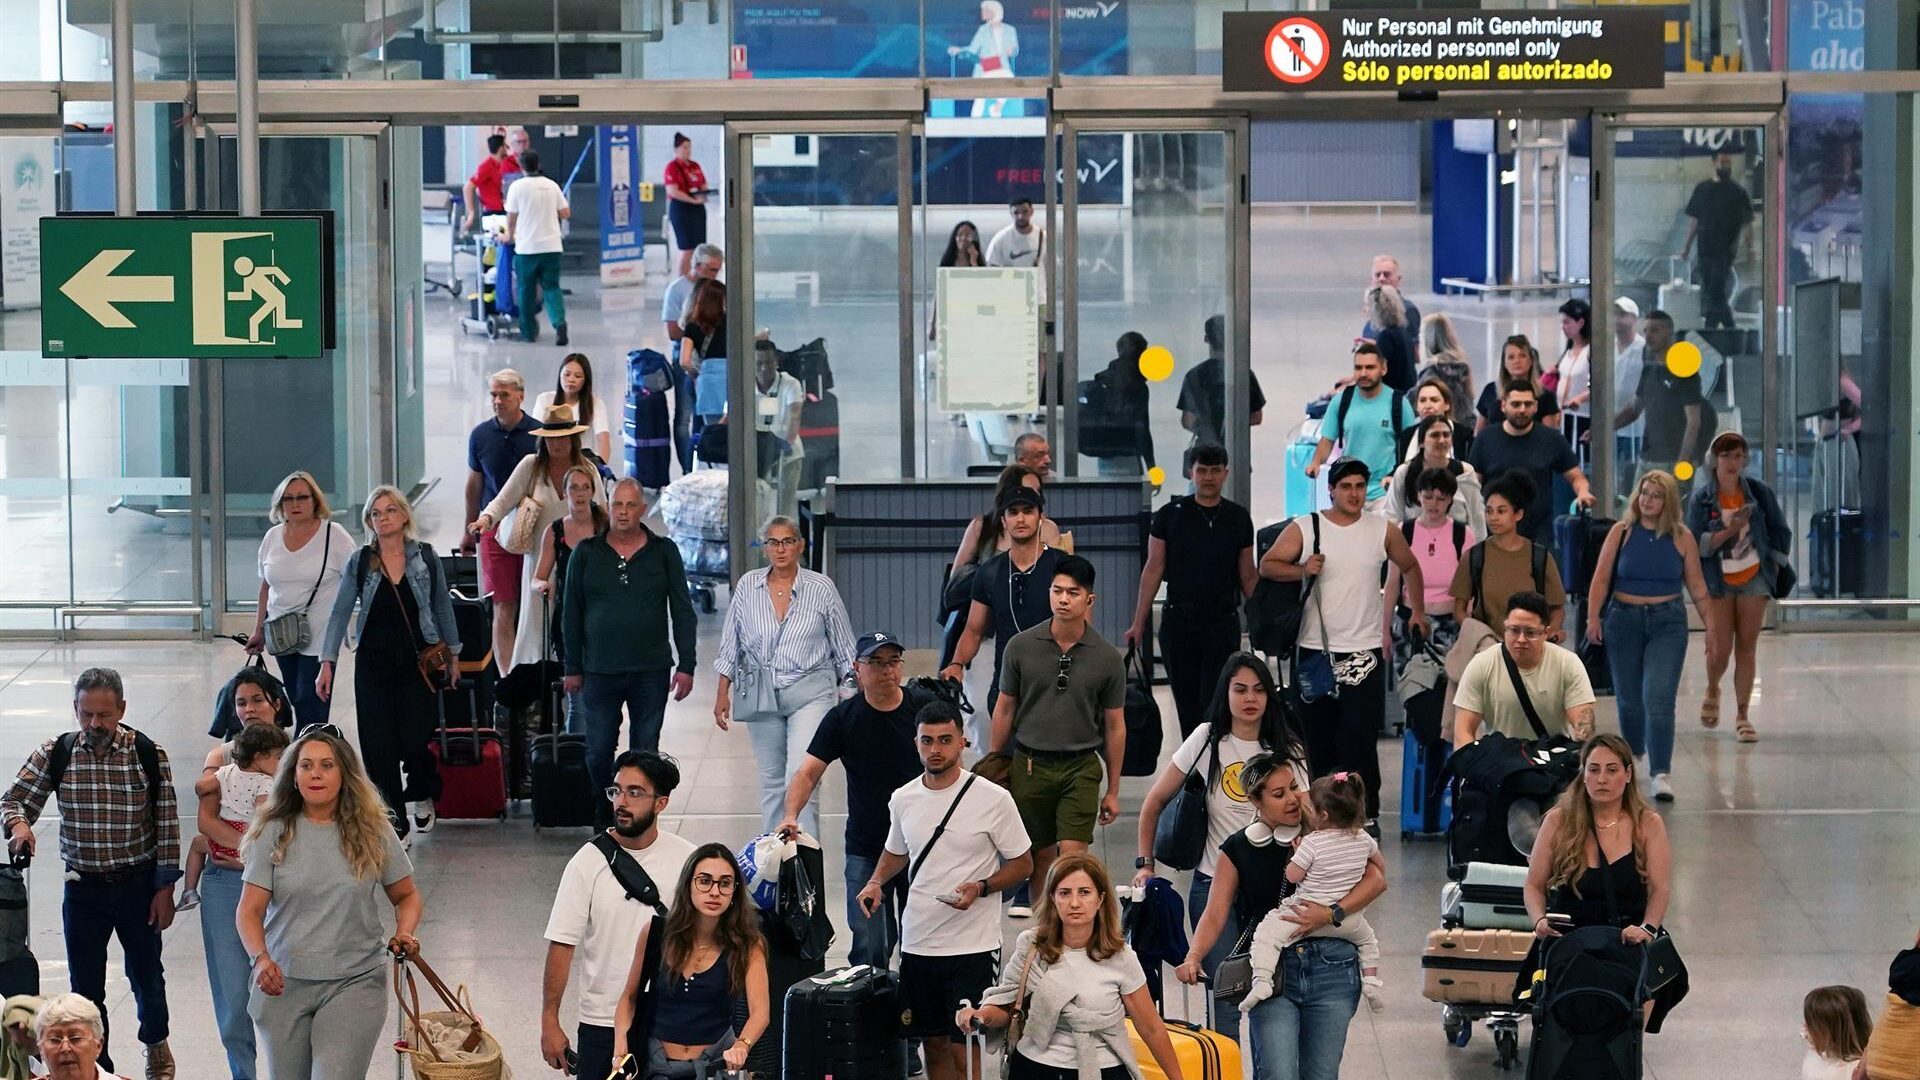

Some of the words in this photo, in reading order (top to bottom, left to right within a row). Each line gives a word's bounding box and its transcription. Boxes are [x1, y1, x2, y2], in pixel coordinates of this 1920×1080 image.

[1342, 18, 1373, 36] Nur
[1378, 17, 1451, 36] Personal
[1457, 17, 1484, 35] mit
[1489, 16, 1603, 38] Genehmigung
[1342, 39, 1432, 58] Authorized
[1438, 38, 1520, 60] personnel
[1525, 38, 1560, 59] only
[1343, 60, 1390, 81] Sólo
[1397, 60, 1490, 85] personal
[1497, 59, 1612, 80] autorizado
